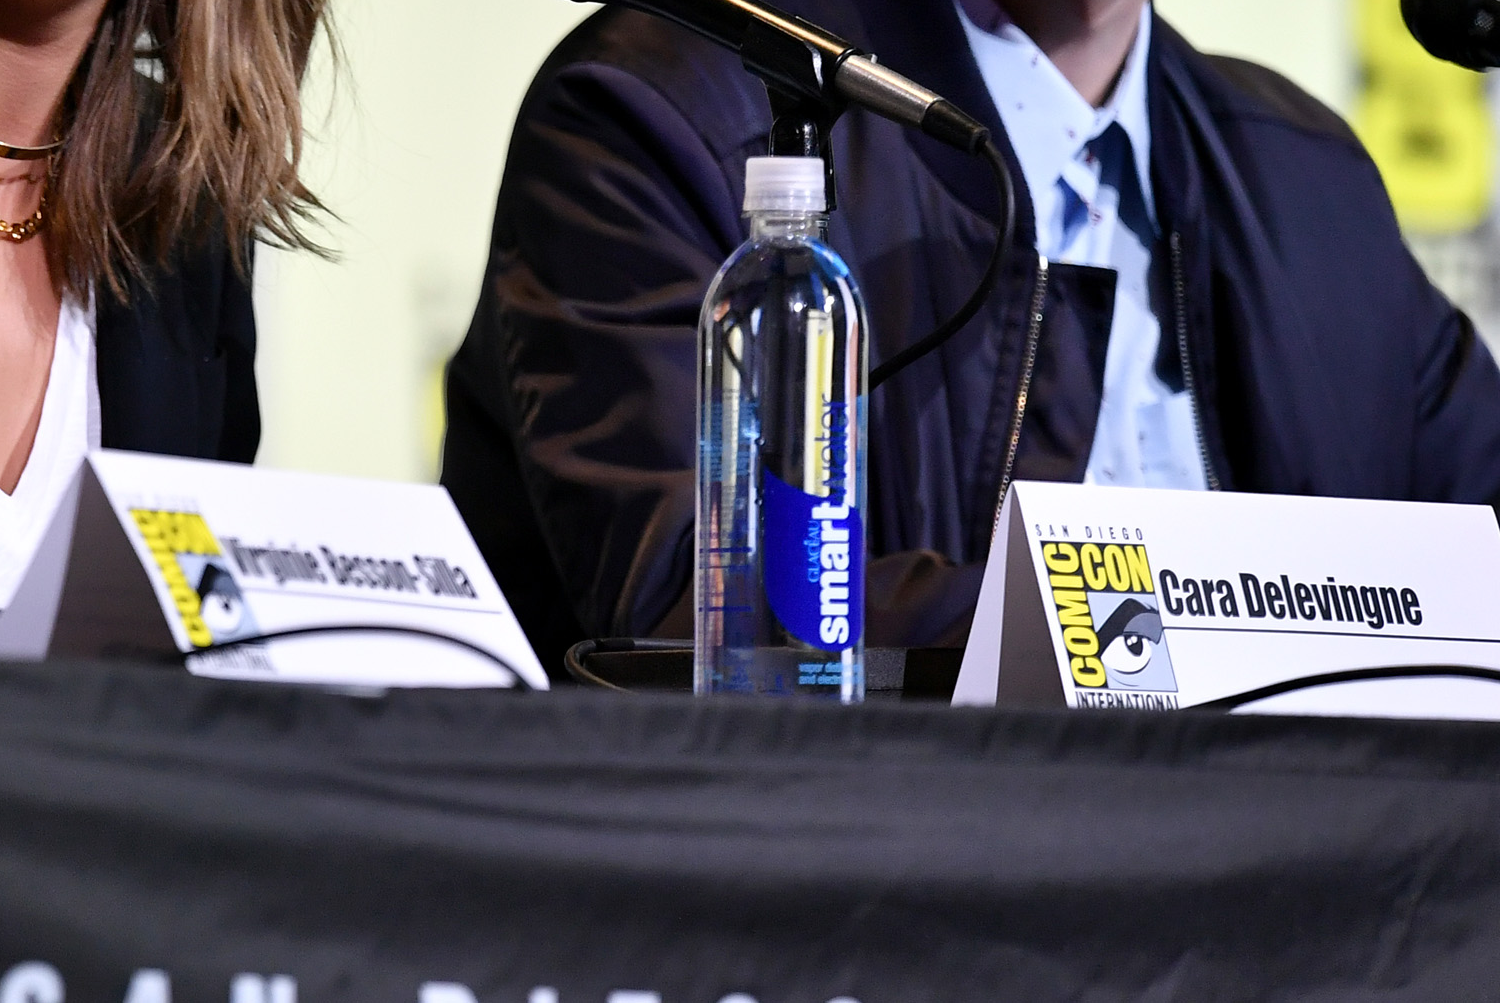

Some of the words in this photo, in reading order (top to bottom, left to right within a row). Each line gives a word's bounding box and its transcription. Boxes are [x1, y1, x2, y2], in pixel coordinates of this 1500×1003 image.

[1035, 524, 1069, 538] SAN
[1085, 526, 1143, 541] DIEGO
[1080, 543, 1155, 592] CON
[1043, 543, 1107, 688] COMIC
[1158, 568, 1240, 618] Cara
[1238, 572, 1423, 630] Delevingne
